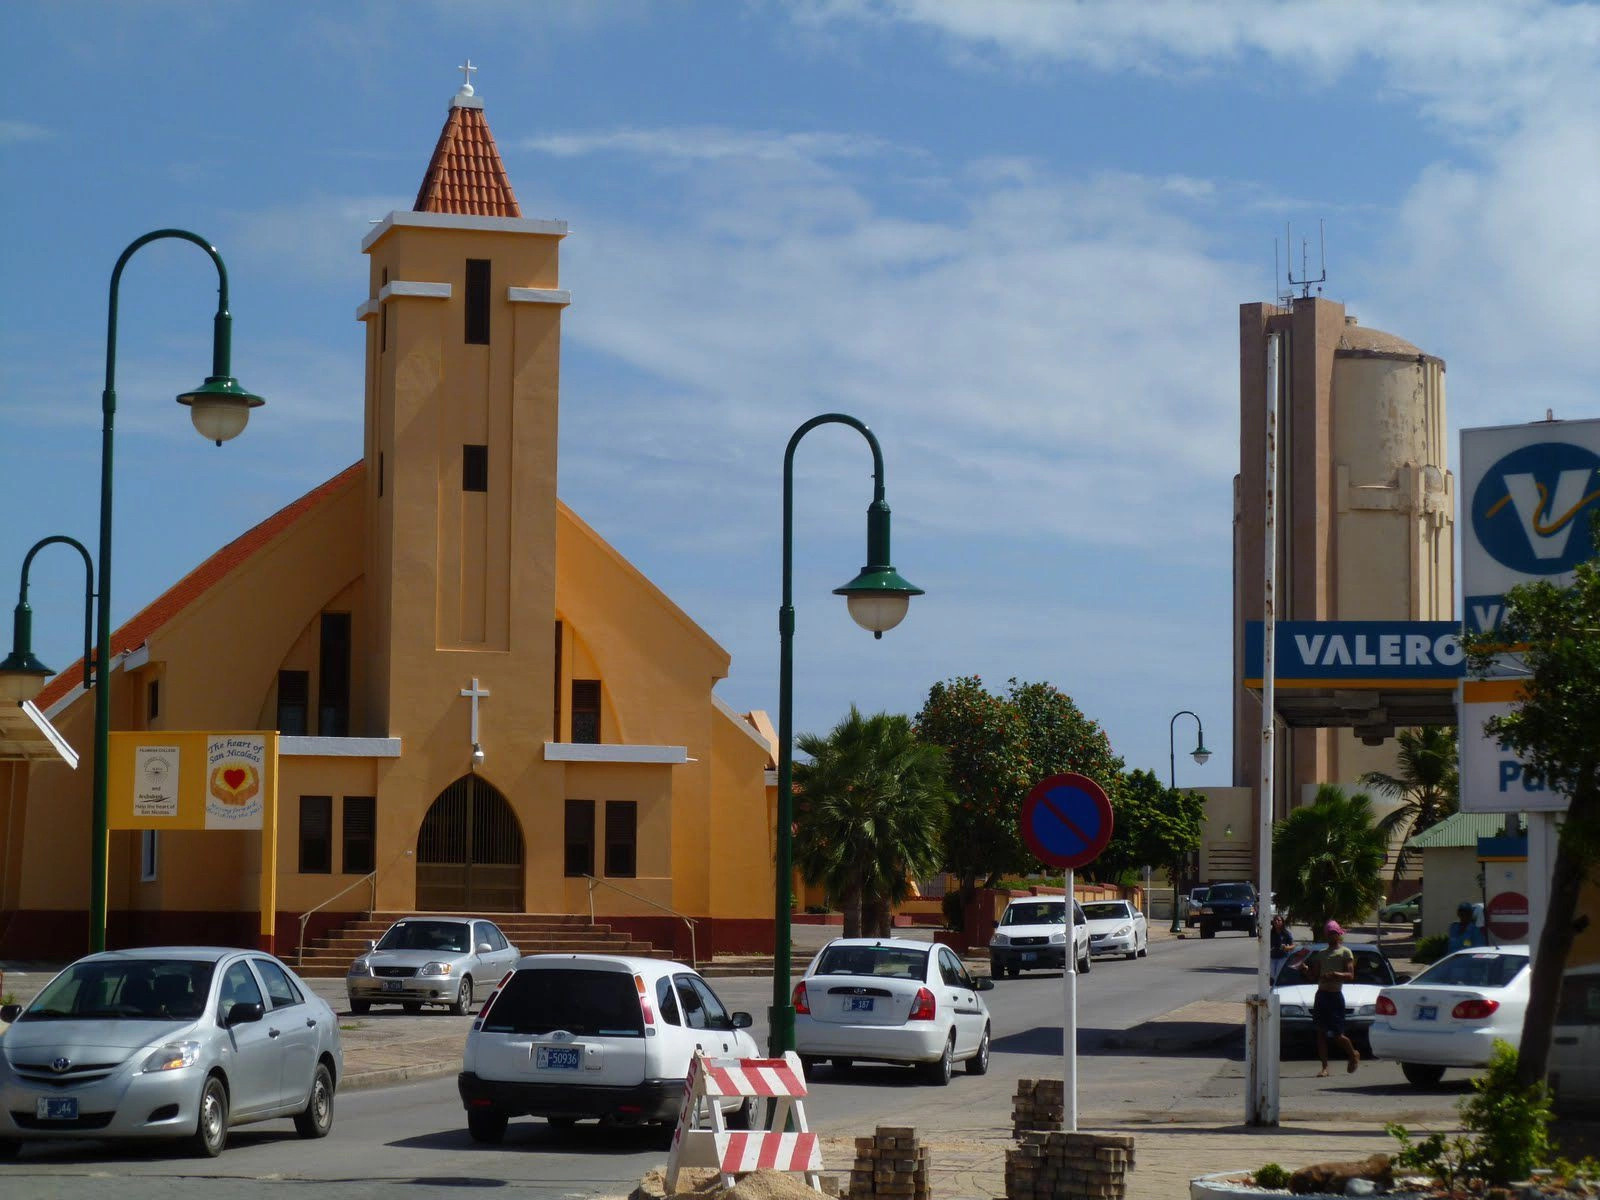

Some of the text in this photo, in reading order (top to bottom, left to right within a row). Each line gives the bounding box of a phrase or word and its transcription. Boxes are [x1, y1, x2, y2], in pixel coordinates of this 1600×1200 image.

[1294, 633, 1465, 666] VALERO
[208, 739, 264, 753] The heart of
[210, 749, 260, 764] San Nicolaas
